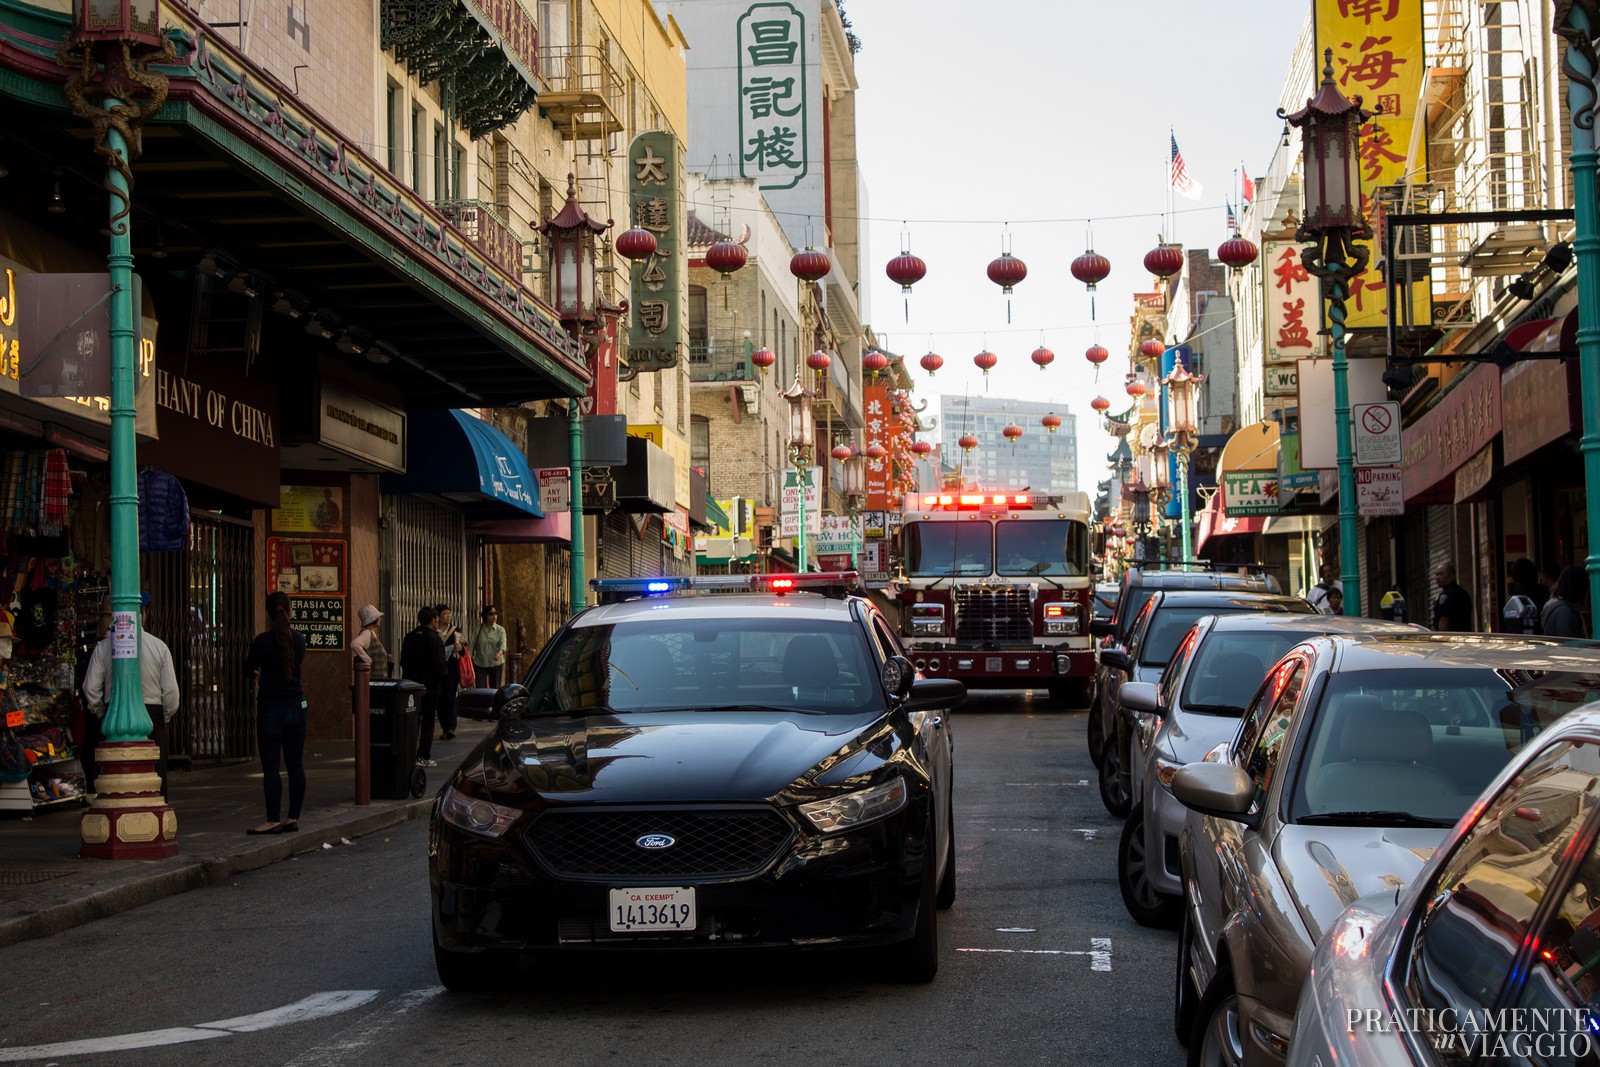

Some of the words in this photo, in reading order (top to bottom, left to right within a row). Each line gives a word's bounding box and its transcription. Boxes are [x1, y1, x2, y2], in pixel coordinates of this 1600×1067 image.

[743, 19, 803, 172] 昌記棧
[206, 389, 226, 429] OF
[231, 400, 275, 448] CHINA
[540, 477, 549, 487] NO
[1358, 470, 1371, 483] NO
[1373, 472, 1401, 481] PARKING
[1225, 480, 1262, 495] TEA
[1361, 487, 1366, 496] 2
[1385, 487, 1390, 495] 6
[1062, 590, 1078, 600] E2
[327, 601, 342, 609] CO.
[644, 837, 666, 847] Ford
[617, 904, 690, 925] 1413619
